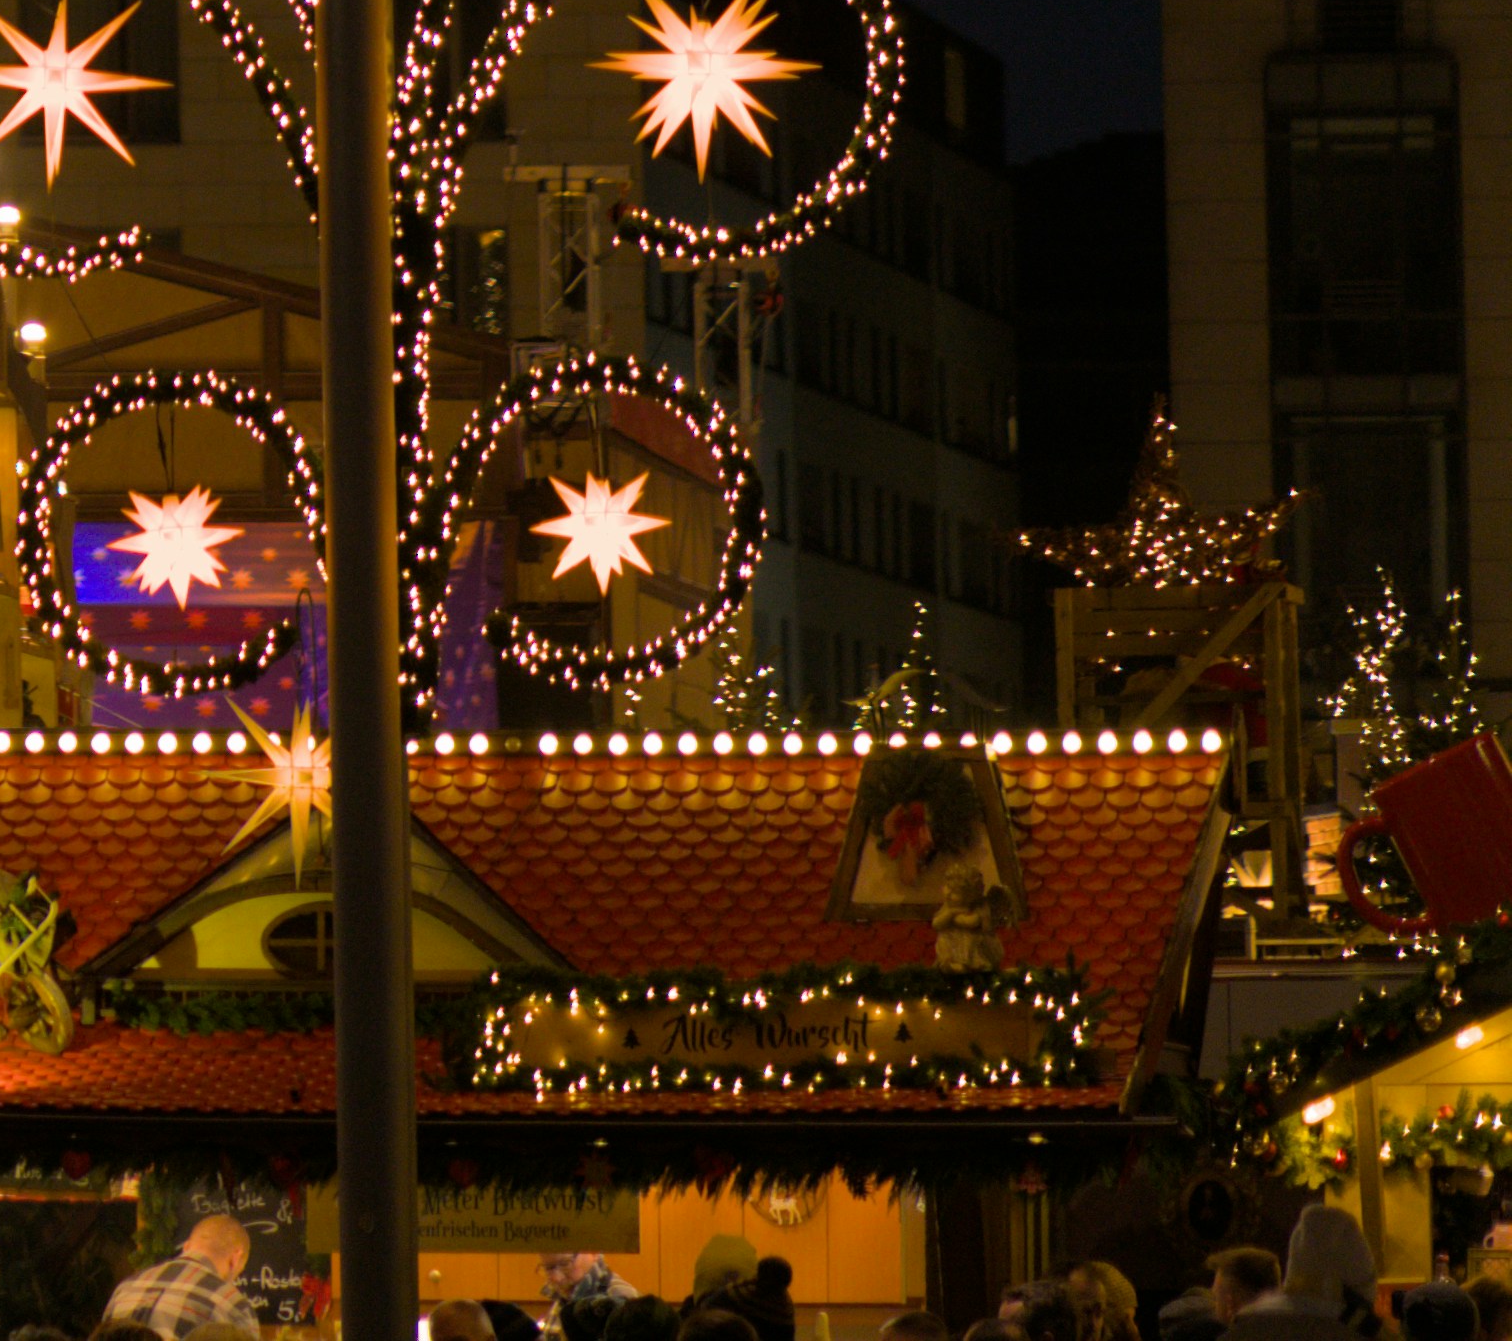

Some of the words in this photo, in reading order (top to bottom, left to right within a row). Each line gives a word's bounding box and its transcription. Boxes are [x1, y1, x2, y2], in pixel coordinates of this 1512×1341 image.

[662, 1014, 734, 1056] Alles
[747, 1011, 881, 1053] Wurscht
[504, 1220, 569, 1242] Baguette
